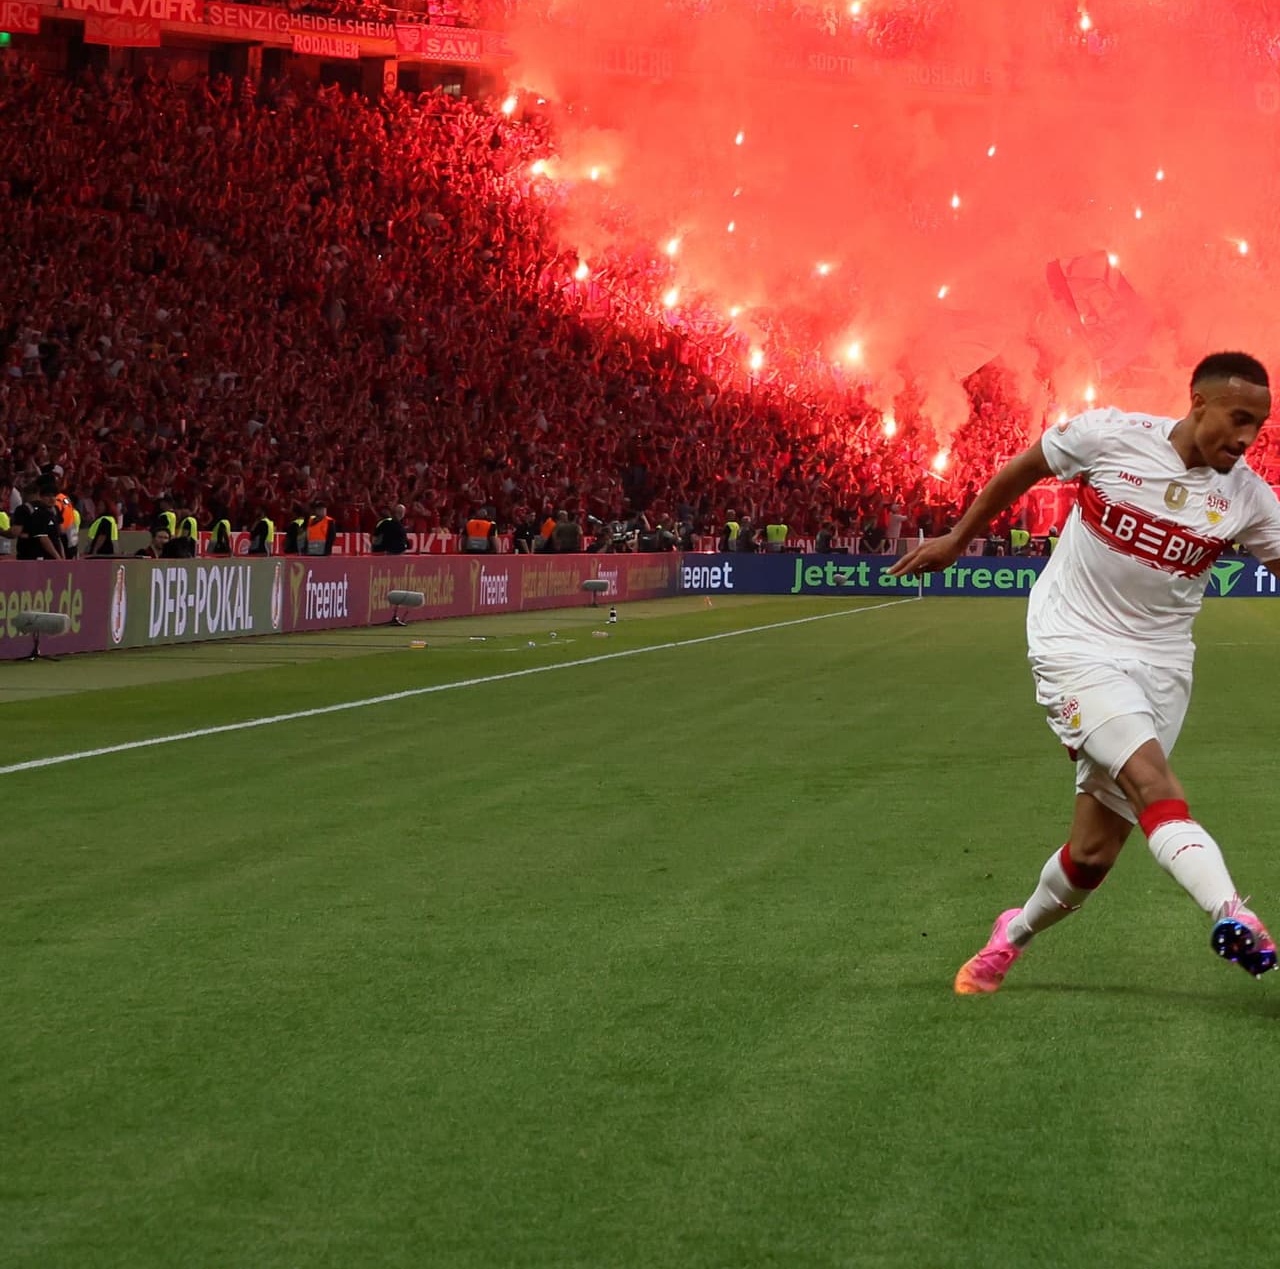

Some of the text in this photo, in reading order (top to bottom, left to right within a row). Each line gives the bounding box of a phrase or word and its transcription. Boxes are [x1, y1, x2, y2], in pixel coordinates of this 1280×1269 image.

[290, 13, 395, 38] HEIDELSHEIM
[294, 34, 360, 58] RODALBEN
[426, 37, 479, 56] SAW
[1117, 470, 1143, 487] JAKO
[480, 564, 509, 606] freenet
[791, 558, 870, 593] Jetzt
[149, 565, 253, 639] DFB-POKAL
[305, 569, 349, 620] freenet
